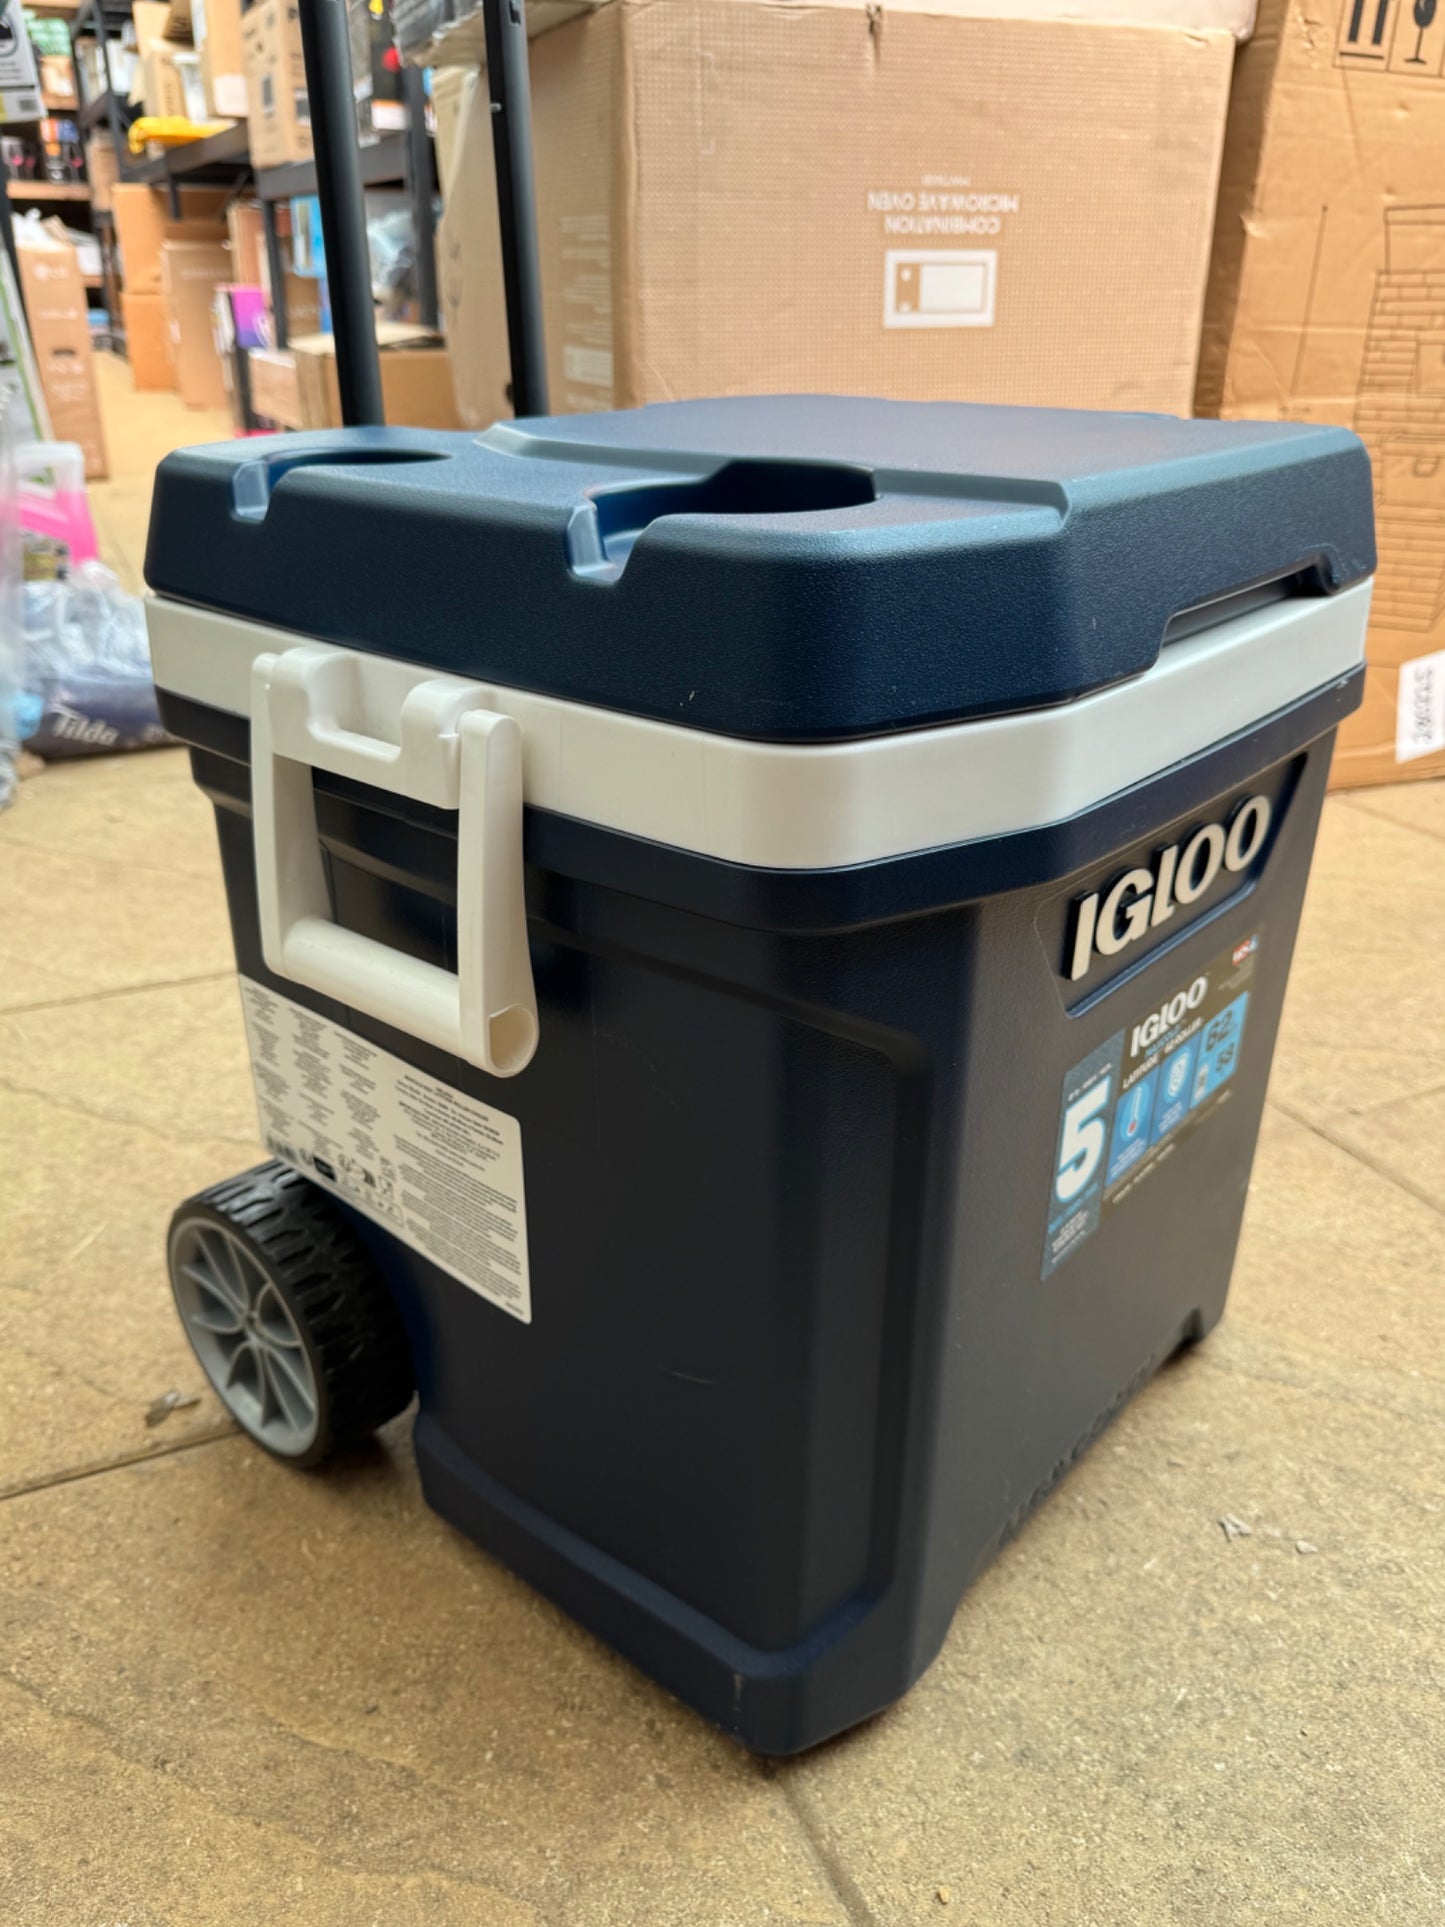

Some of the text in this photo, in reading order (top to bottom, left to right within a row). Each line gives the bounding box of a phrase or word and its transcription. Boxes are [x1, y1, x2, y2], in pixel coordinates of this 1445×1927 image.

[868, 191, 1020, 213] MICROWAVE OVEN
[885, 216, 1001, 234] COMBINATION
[54, 714, 118, 746] Tilda
[1069, 795, 1271, 981] IGLOO
[1130, 976, 1208, 1057] IGLOO
[1057, 1076, 1111, 1202] 5
